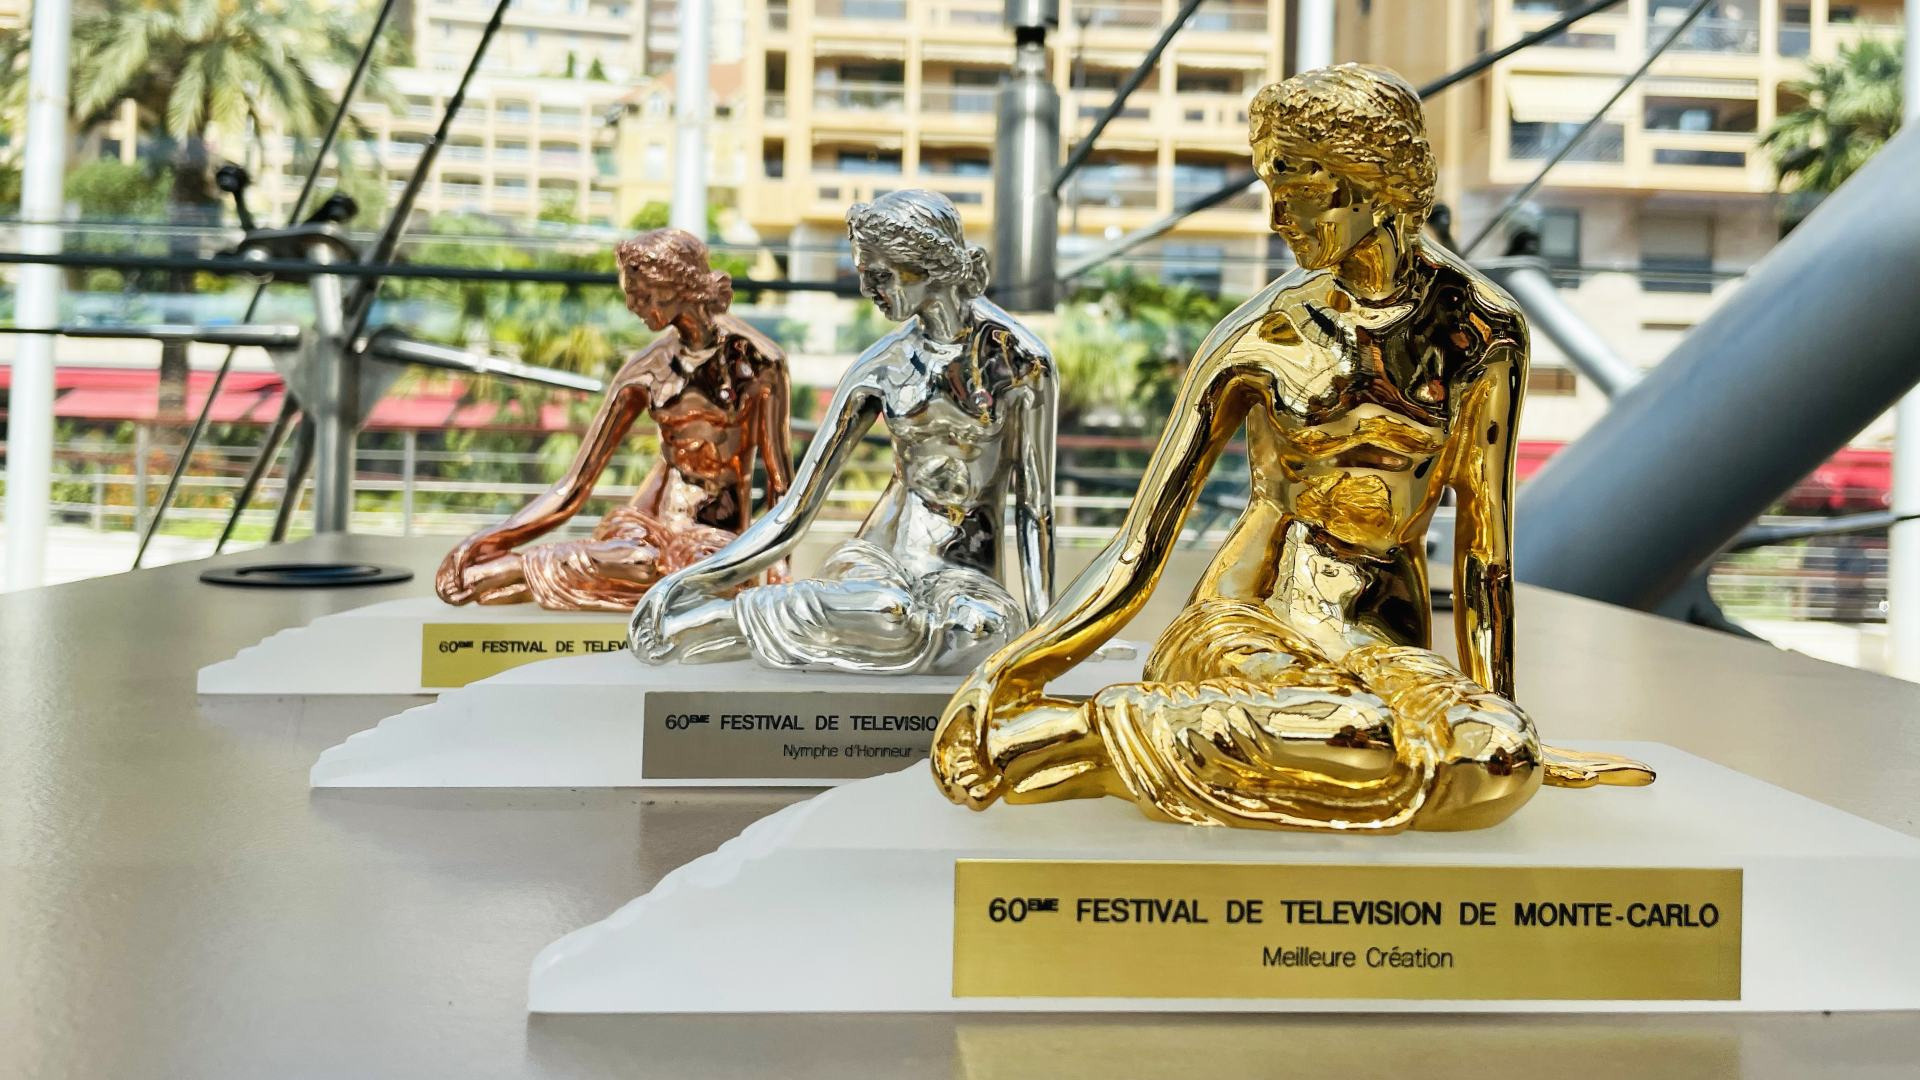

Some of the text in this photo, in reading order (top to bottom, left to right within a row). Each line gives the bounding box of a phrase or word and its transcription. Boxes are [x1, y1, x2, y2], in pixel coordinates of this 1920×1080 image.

[482, 640, 548, 653] FESTIVAL
[556, 640, 574, 653] DE
[720, 715, 804, 730] FESTIVAL
[815, 715, 839, 731] DE
[783, 744, 838, 759] Nymphe
[845, 744, 912, 758] d'Honneur
[1076, 898, 1208, 923] FESTIVAL
[1226, 900, 1263, 924] DE
[1281, 900, 1442, 926] TELEVISION
[1459, 902, 1496, 926] DE
[1514, 902, 1720, 928] MONTE-CARLO
[1263, 946, 1454, 969] Meilleure Création
